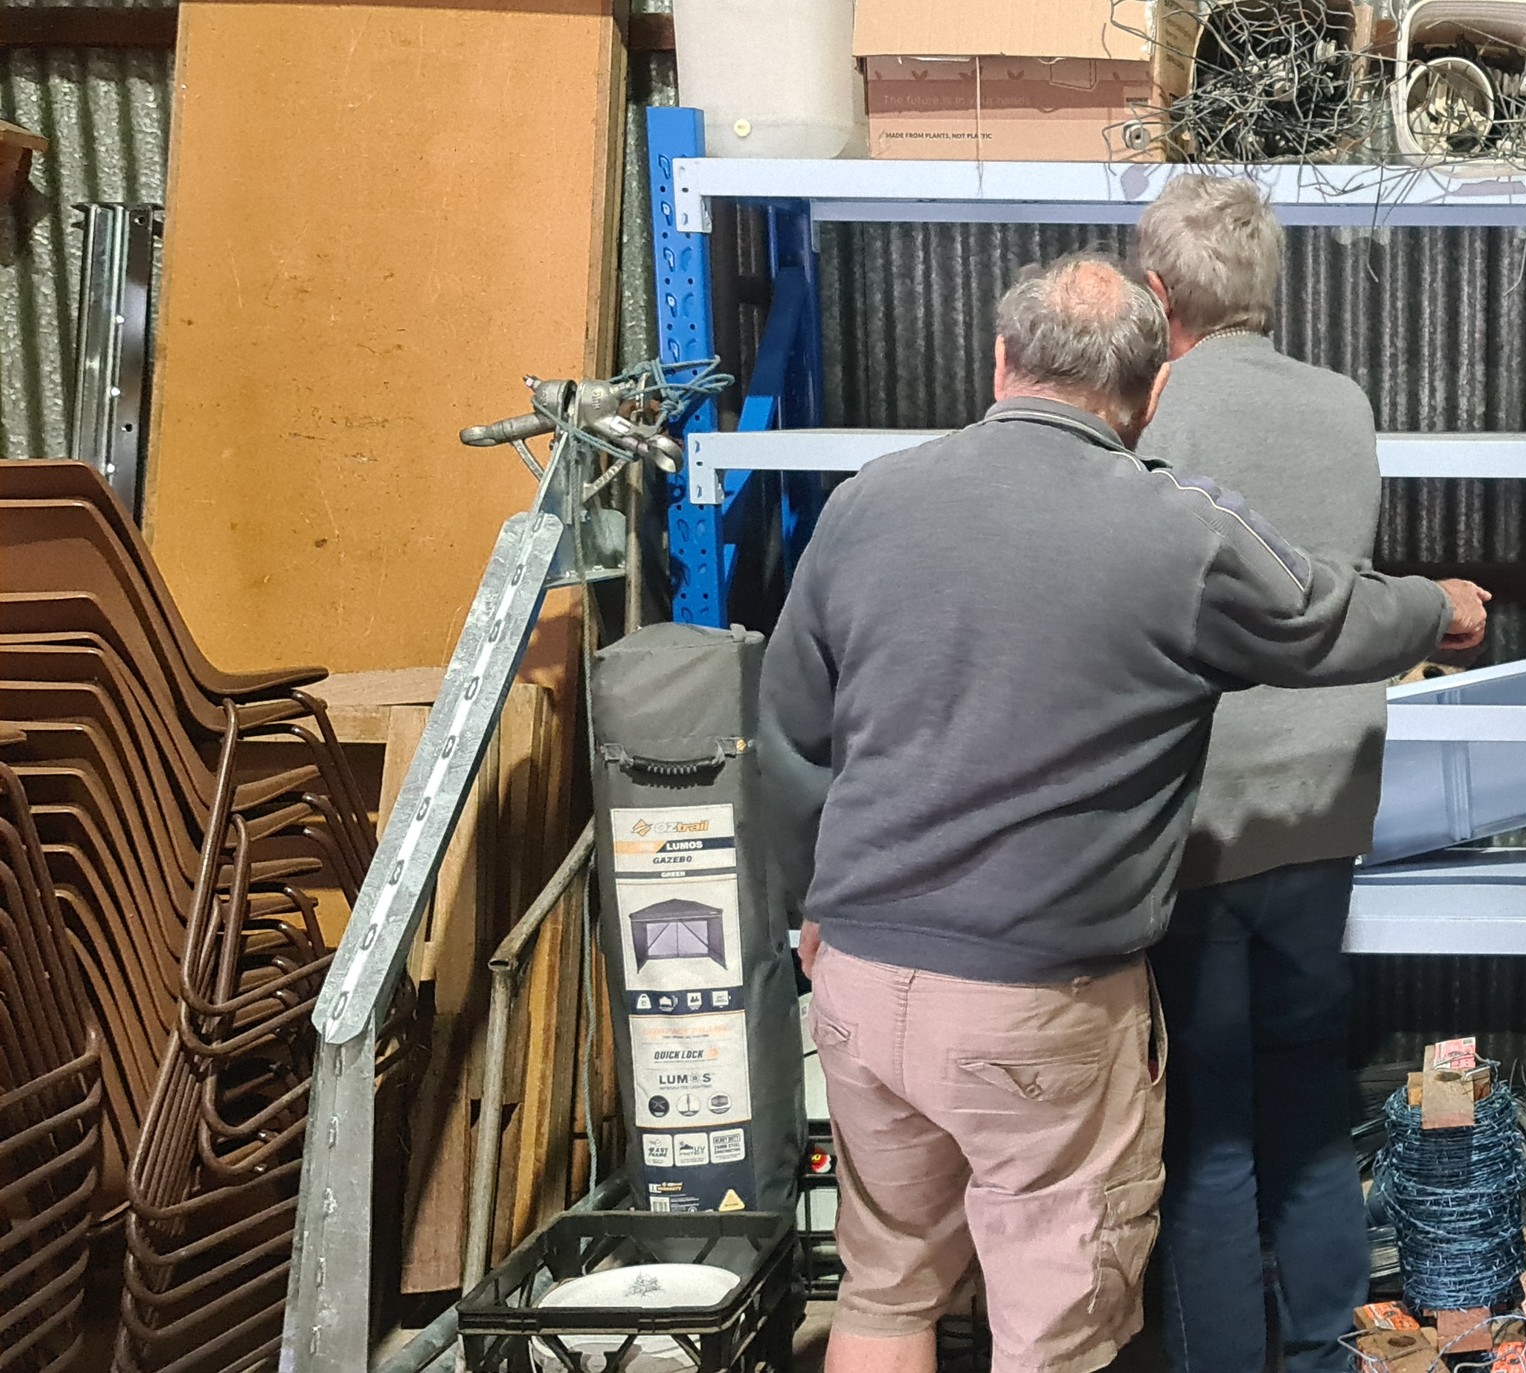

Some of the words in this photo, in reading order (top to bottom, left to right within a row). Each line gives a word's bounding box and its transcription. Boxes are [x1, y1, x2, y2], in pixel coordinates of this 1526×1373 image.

[969, 96, 994, 106] yur
[666, 841, 703, 850] LUMOS
[652, 855, 693, 864] GAZEBO
[654, 1050, 680, 1060] QUICK
[681, 1049, 704, 1059] LOCK
